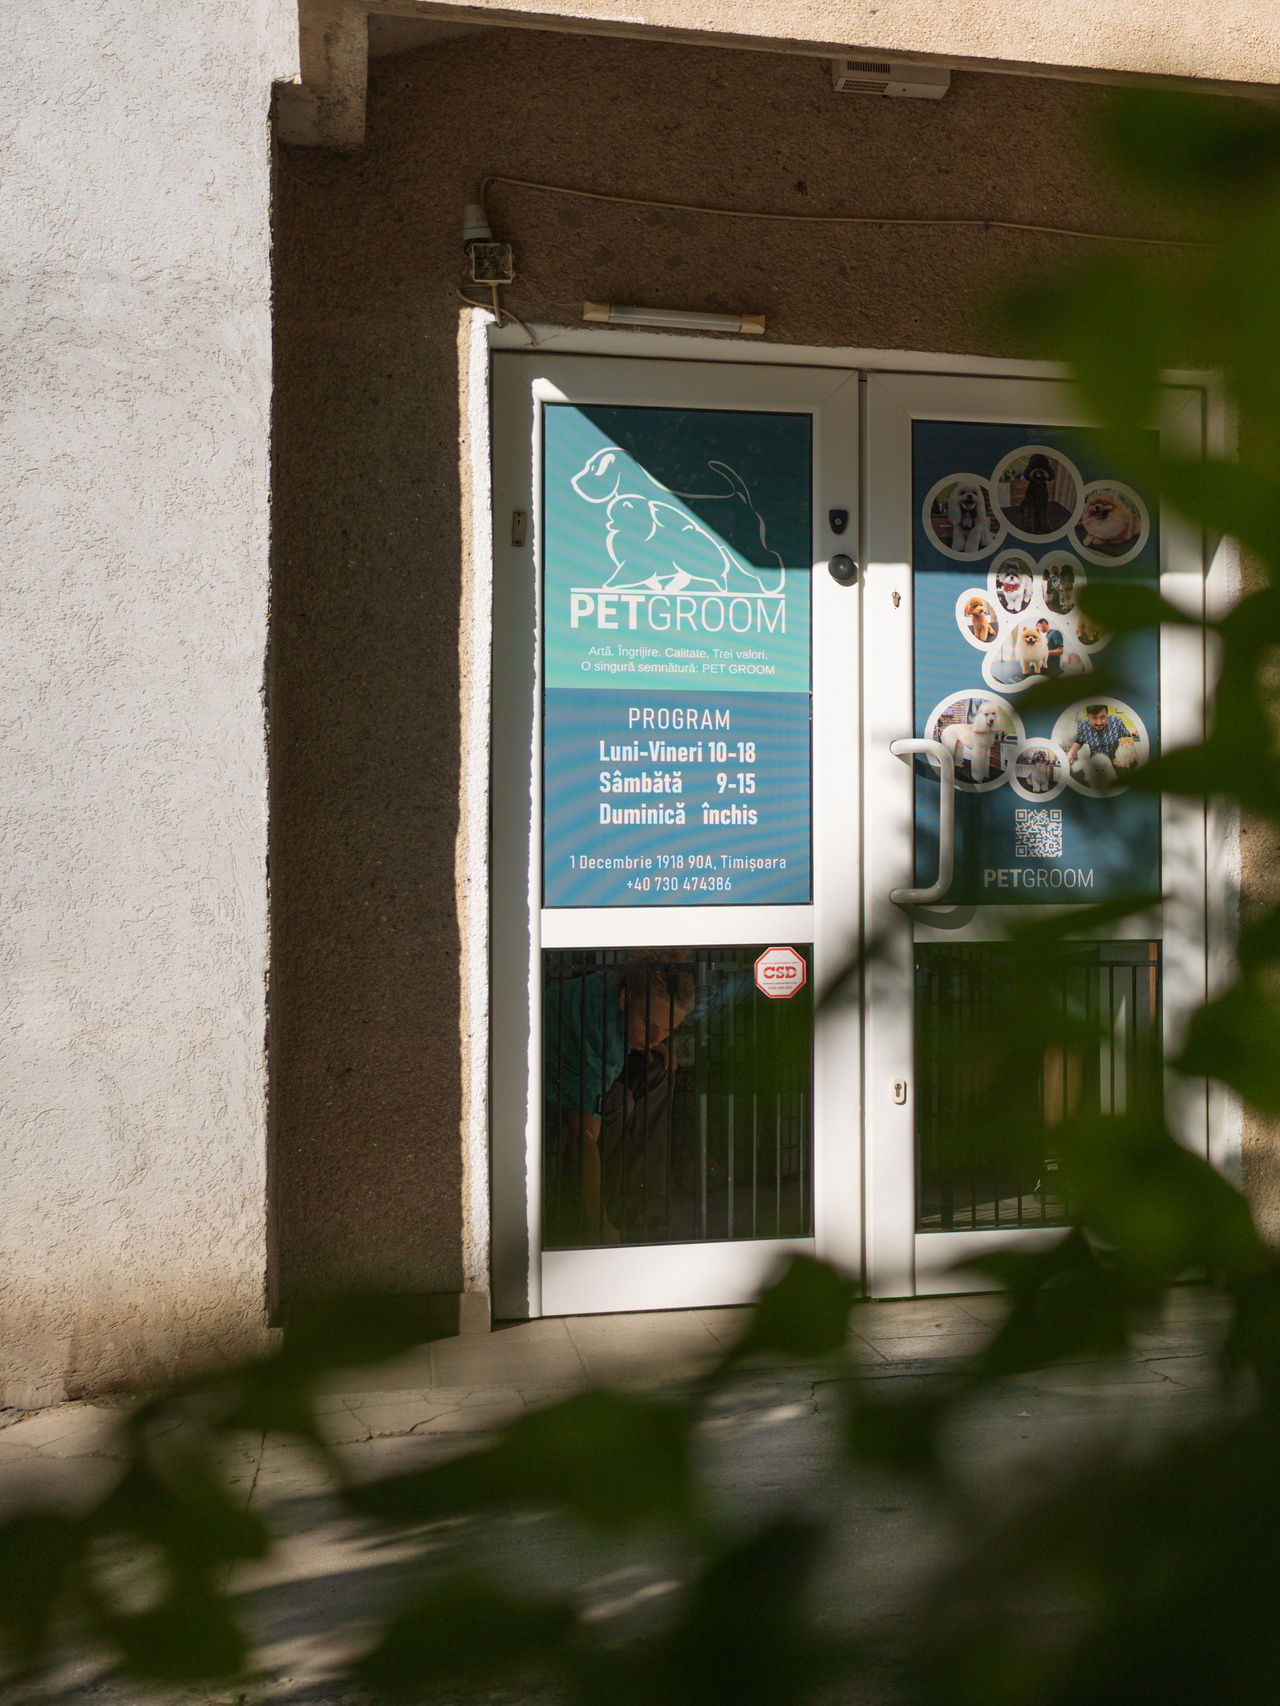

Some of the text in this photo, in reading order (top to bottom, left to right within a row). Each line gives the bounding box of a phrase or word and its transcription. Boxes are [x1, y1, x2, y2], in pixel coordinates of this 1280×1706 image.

[570, 593, 786, 634] PETGROOM
[588, 644, 768, 660] Artă. Îngrijire. Calitate. Trei valori.
[581, 660, 776, 675] O singură semnătură: PET GROOM
[628, 707, 731, 731] PROGRAM
[599, 740, 756, 763] Luni-Vineri 10-18
[599, 769, 756, 794] Sâmbătă 9-15
[599, 801, 758, 826] Duminică închis
[569, 854, 787, 873] 1 Decembrie 1918 90A, Timișoara
[626, 876, 732, 891] +40 730 474386
[983, 868, 1094, 888] PETGROOM
[763, 966, 797, 979] CSD
